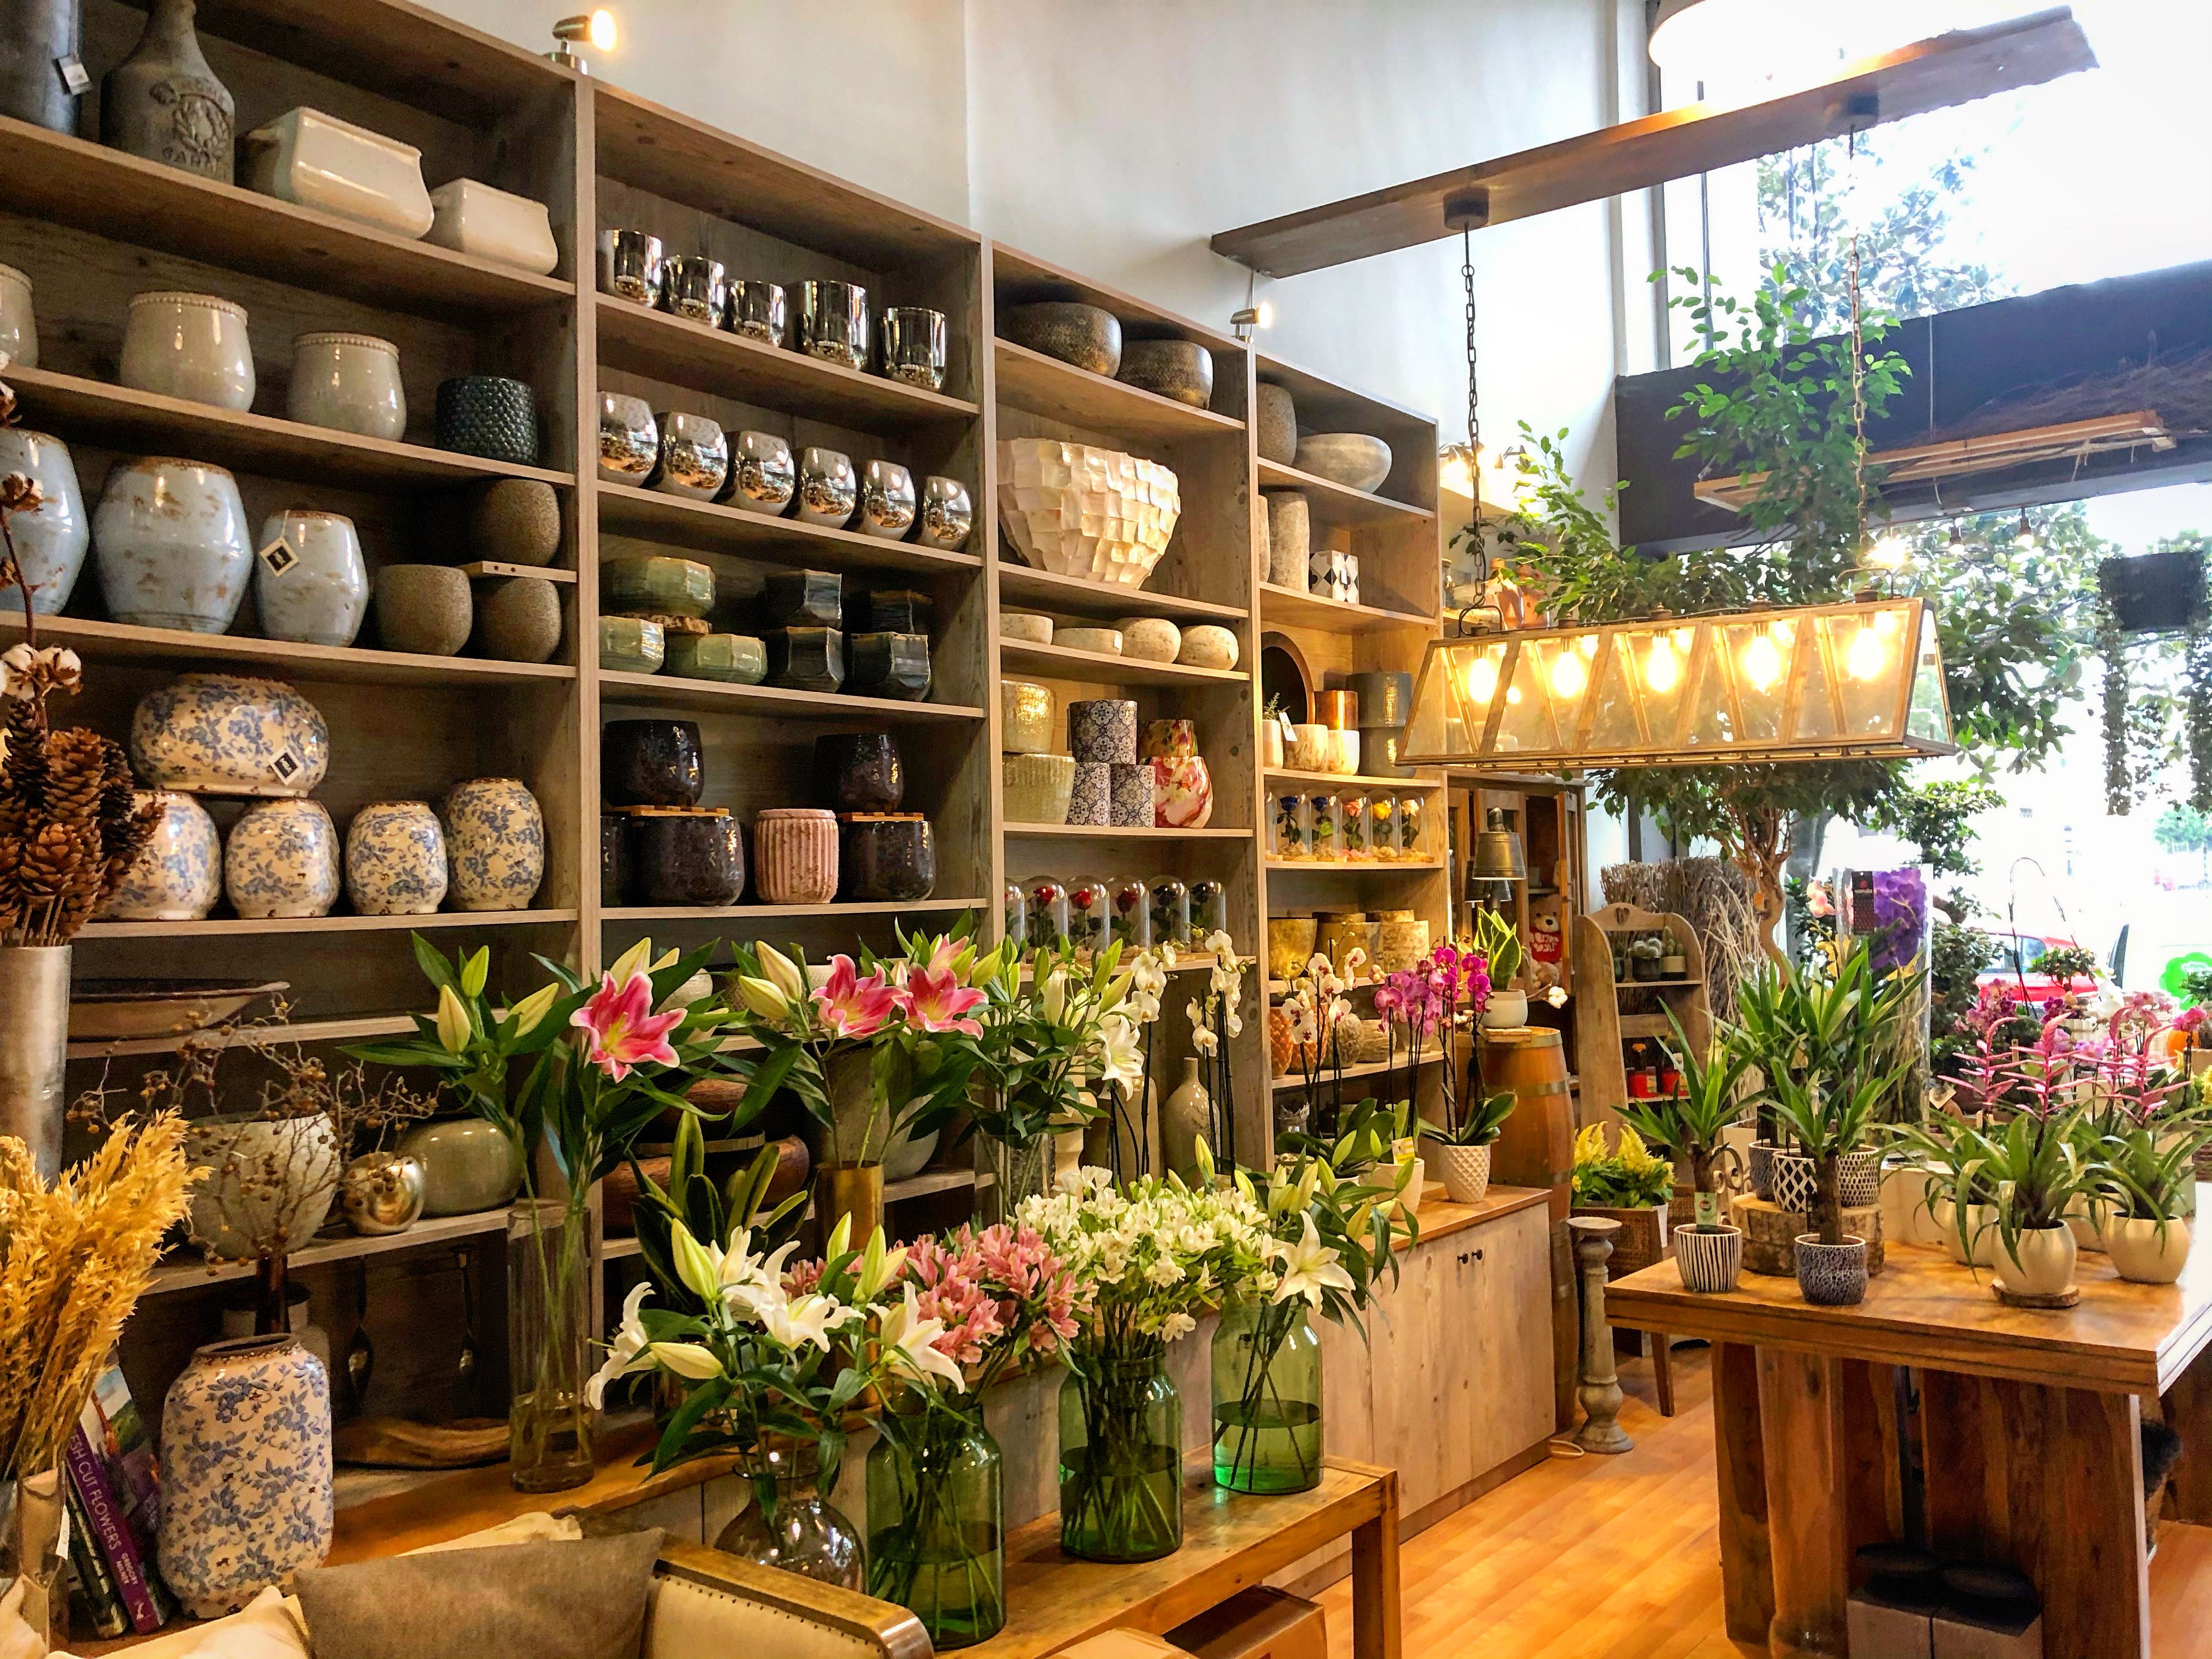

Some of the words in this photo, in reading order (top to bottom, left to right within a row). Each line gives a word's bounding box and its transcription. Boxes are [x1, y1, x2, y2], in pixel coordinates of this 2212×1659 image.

[70, 1434, 83, 1460] ESH
[78, 1462, 98, 1488] CUT
[89, 1488, 122, 1550] FLOWERS
